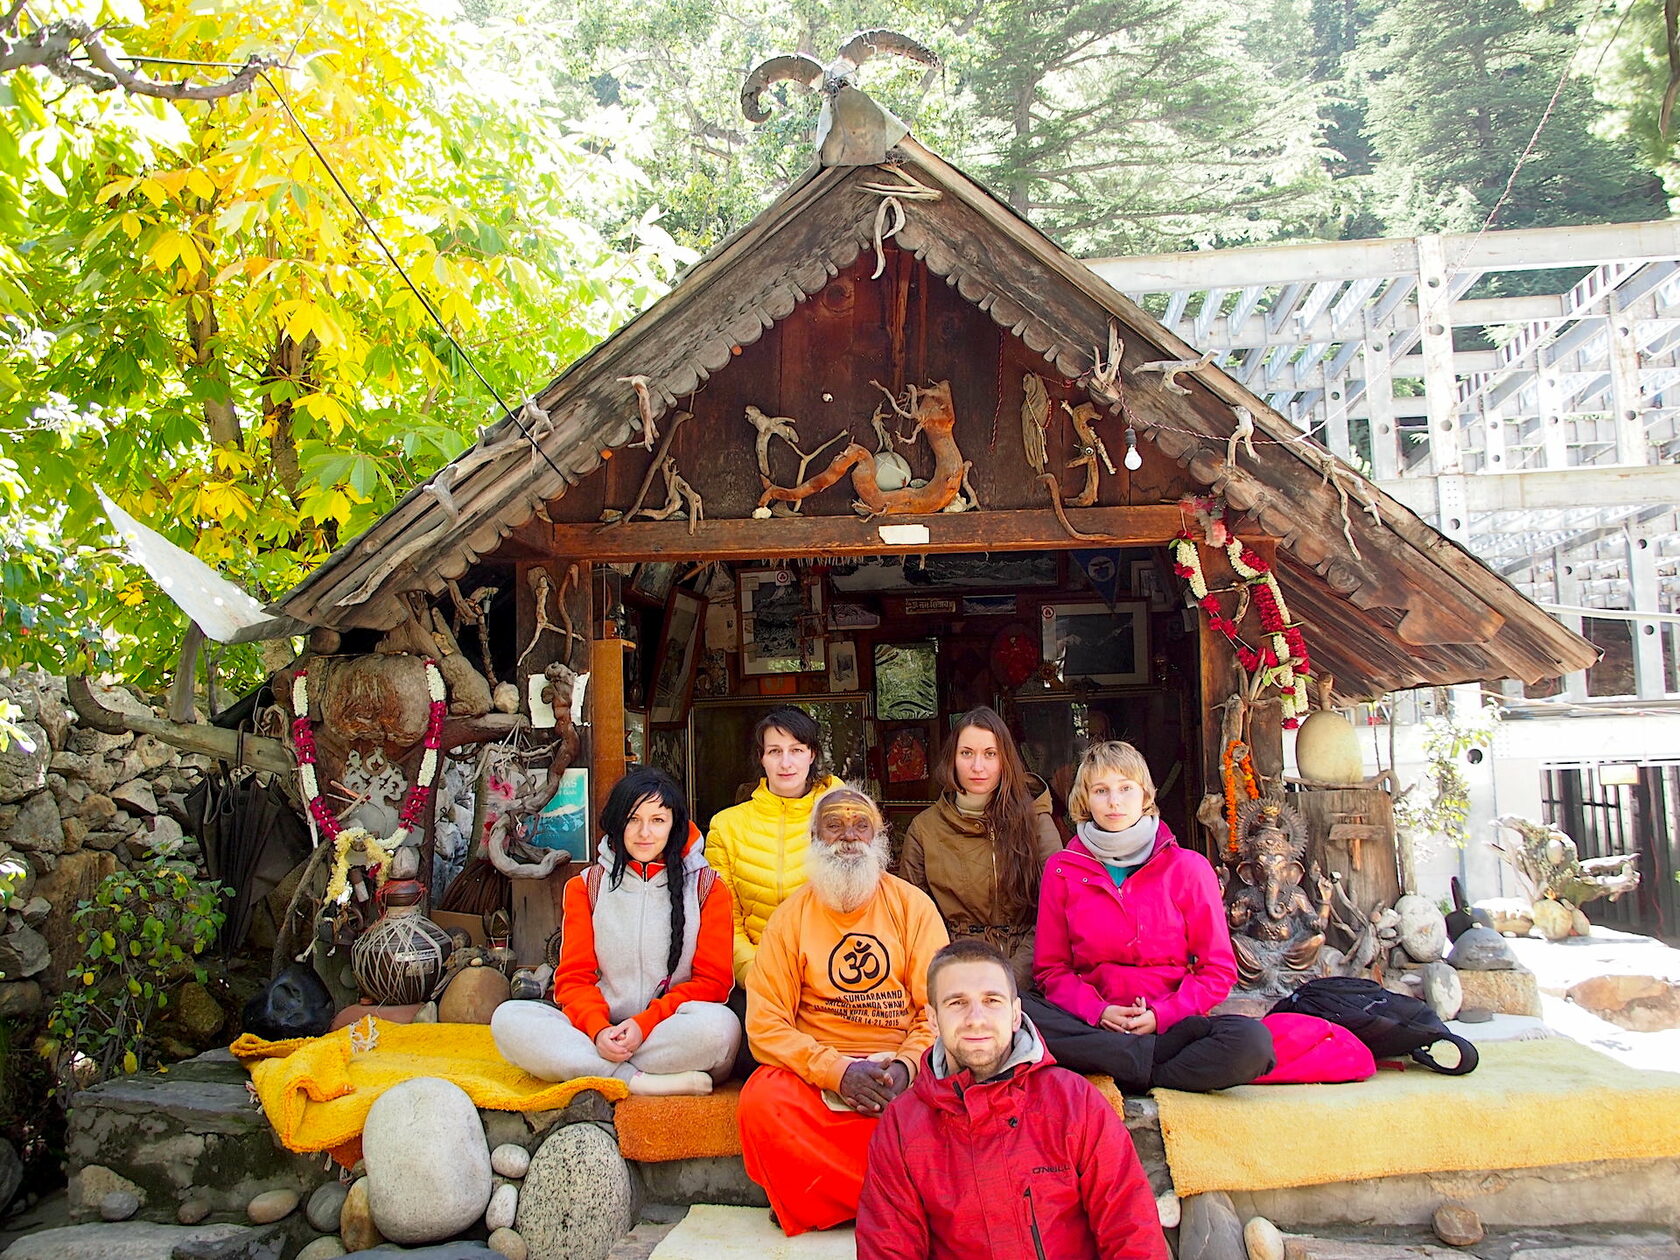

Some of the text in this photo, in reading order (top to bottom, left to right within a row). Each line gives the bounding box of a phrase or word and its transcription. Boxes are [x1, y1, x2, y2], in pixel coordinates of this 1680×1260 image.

[839, 940, 880, 984] ॐ
[843, 990, 903, 1003] SUNDARANAND
[883, 1000, 905, 1009] SWAMI
[885, 1019, 900, 1027] 2015
